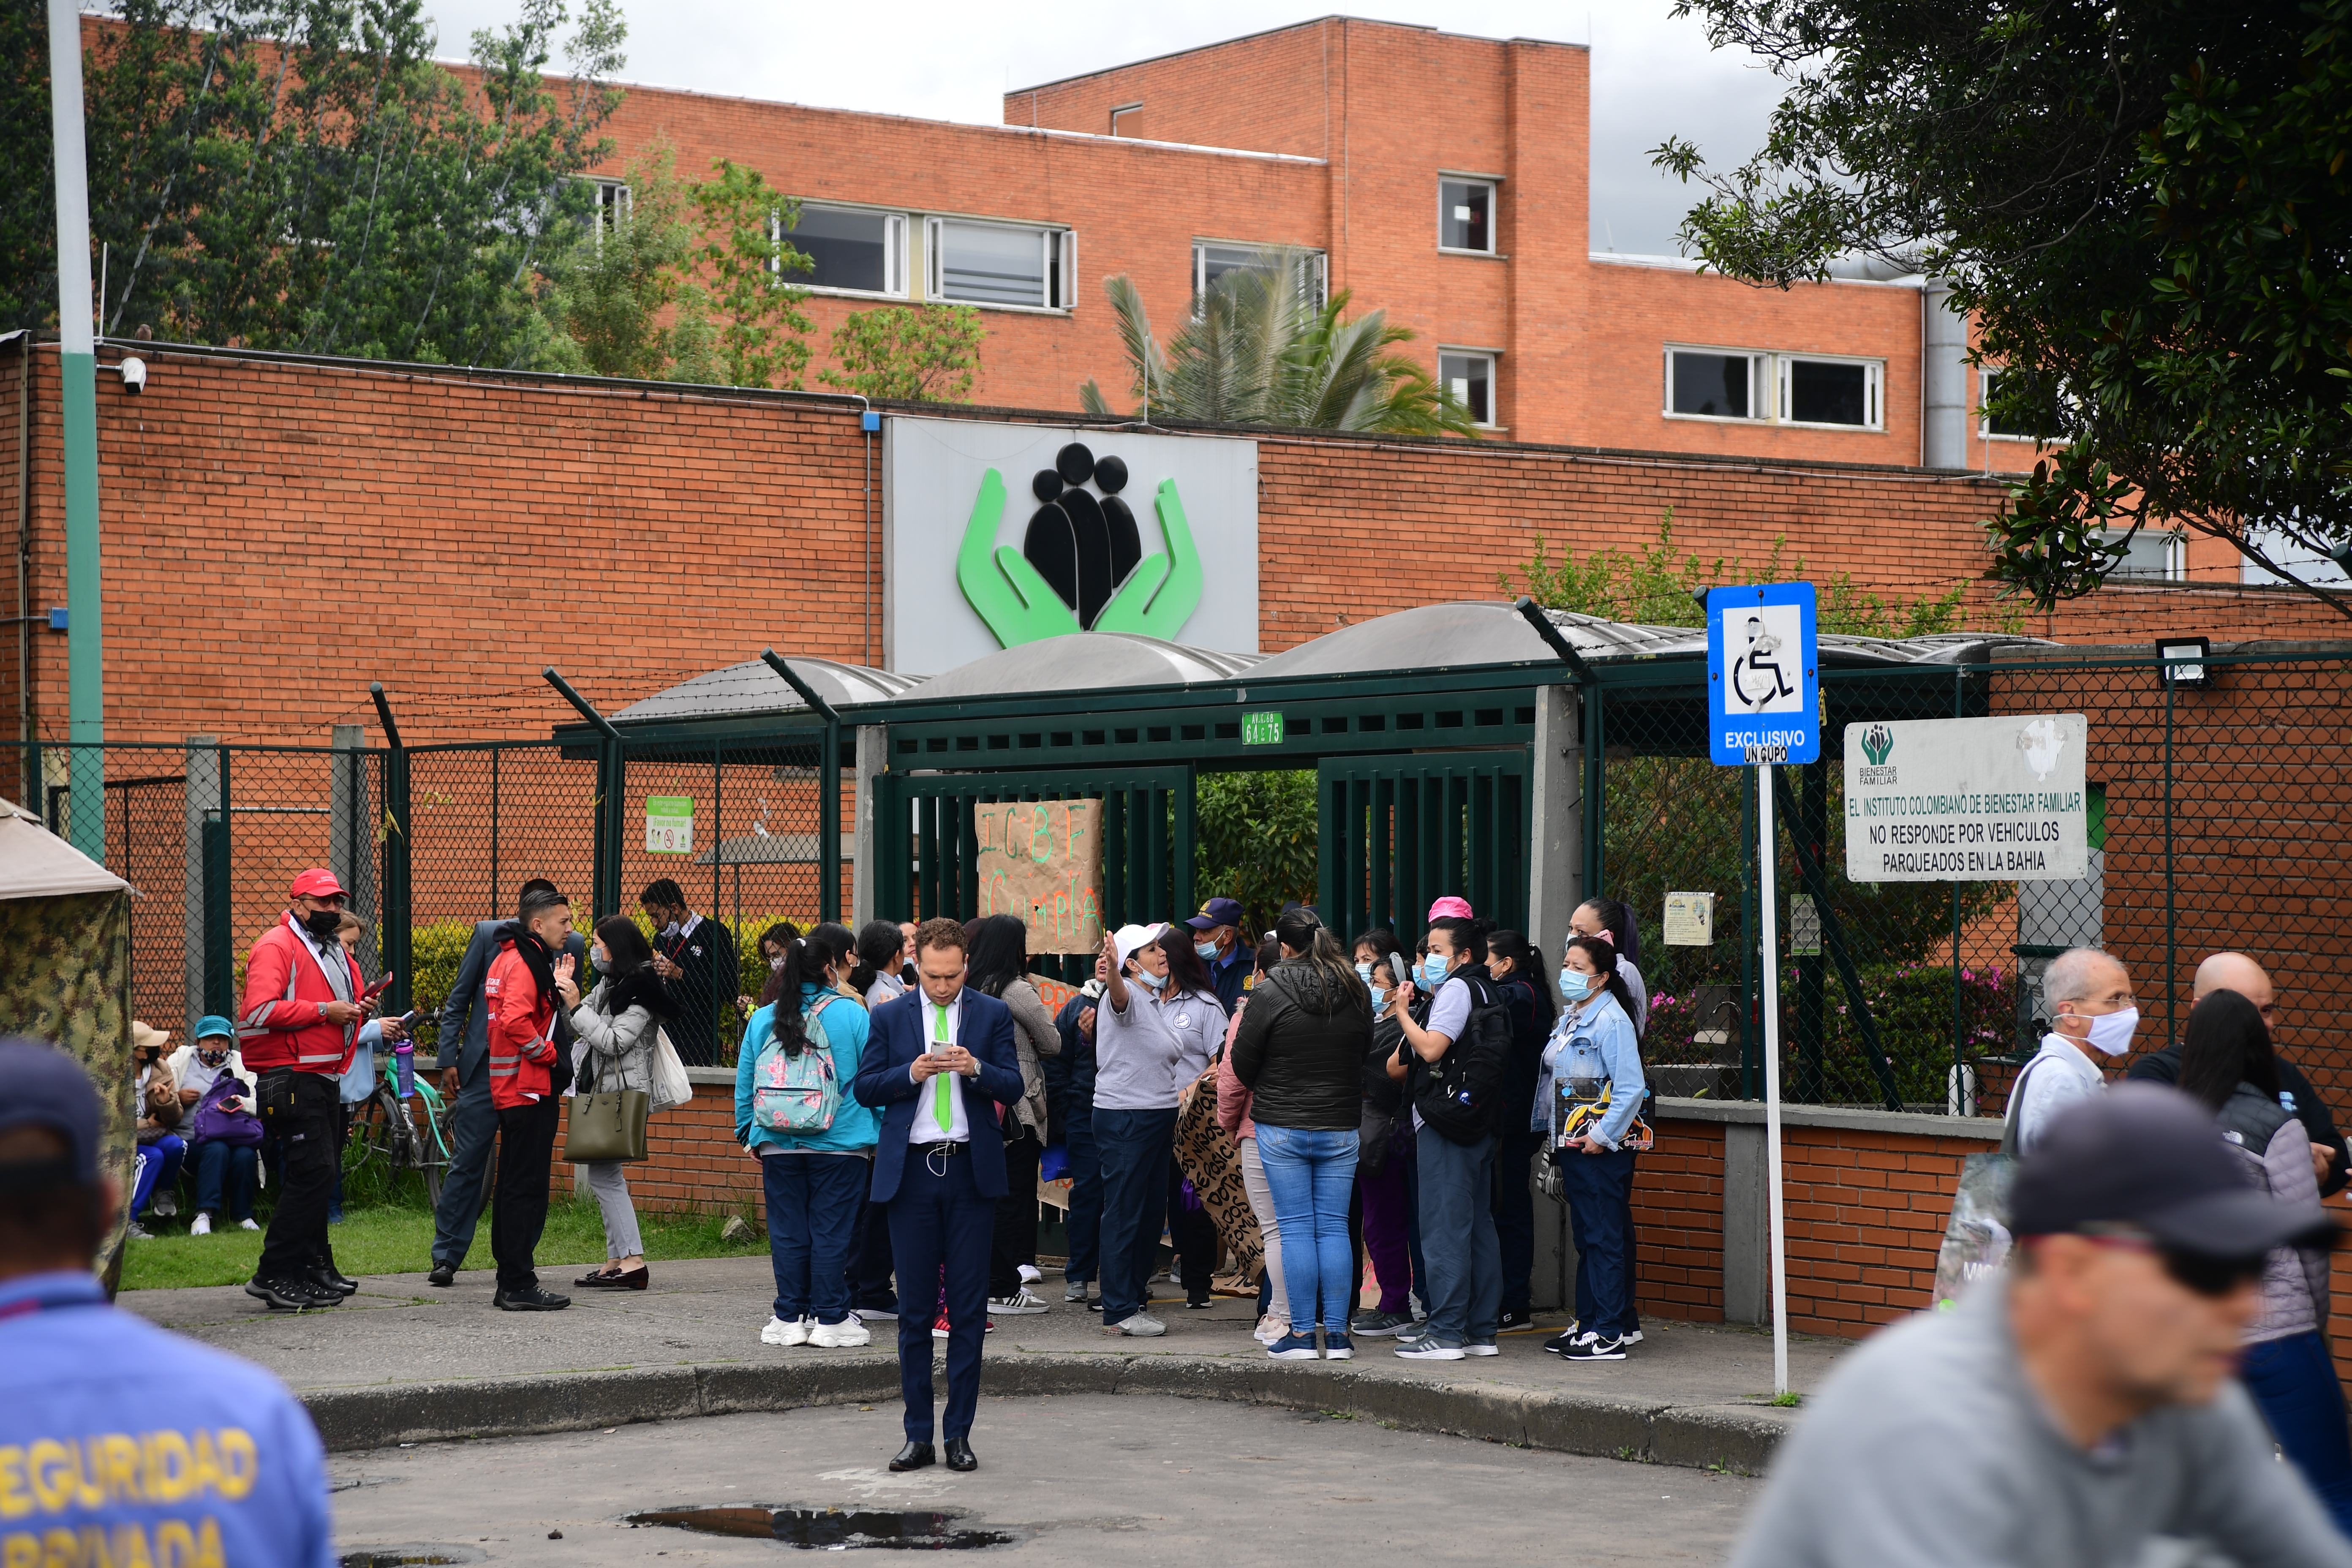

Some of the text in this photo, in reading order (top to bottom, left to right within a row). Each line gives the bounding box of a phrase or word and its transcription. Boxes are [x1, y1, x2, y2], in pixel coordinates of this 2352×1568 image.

[1725, 730, 1805, 748] EXCLUSIVO
[1745, 748, 1758, 762] UN
[1859, 766, 1897, 776] BIENESTAR
[1859, 776, 1897, 786] FAMILIAR
[1849, 792, 2081, 817] EL INSTITUTO COLOMBIANO DE BIENESTAR FAMILIAR
[672, 818, 686, 827] fumar!
[1870, 821, 2059, 844] NO RESPONDE POR VEHICULOS
[1883, 850, 2046, 873] PARQUEADOS EN LA BAHIA
[1181, 1116, 1226, 1174] OS NIÑOS
[1228, 1214, 1258, 1248] COMU
[1240, 1239, 1265, 1271] ERIAL
[0, 1426, 257, 1518] EGURIDAD
